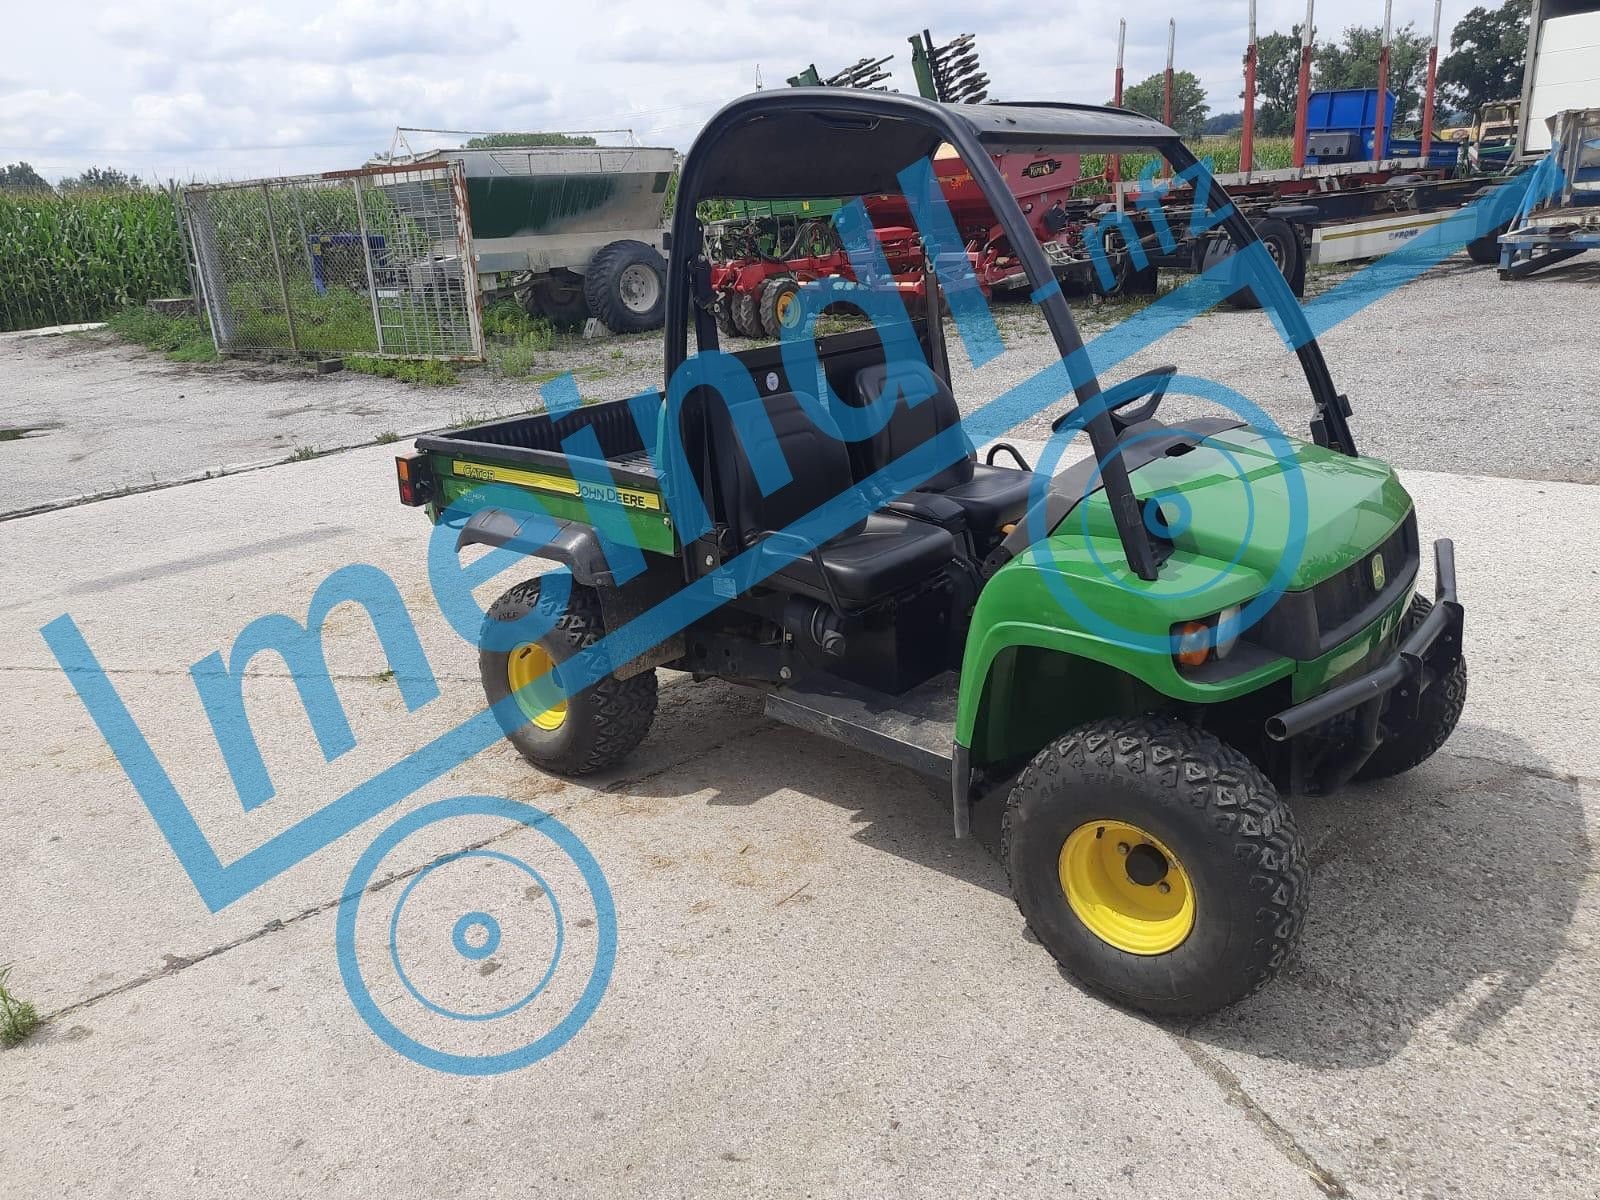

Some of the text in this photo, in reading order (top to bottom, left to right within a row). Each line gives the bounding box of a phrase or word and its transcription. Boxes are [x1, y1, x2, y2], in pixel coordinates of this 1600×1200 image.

[463, 464, 496, 482] GATOR
[575, 480, 645, 507] JOHN DEERE
